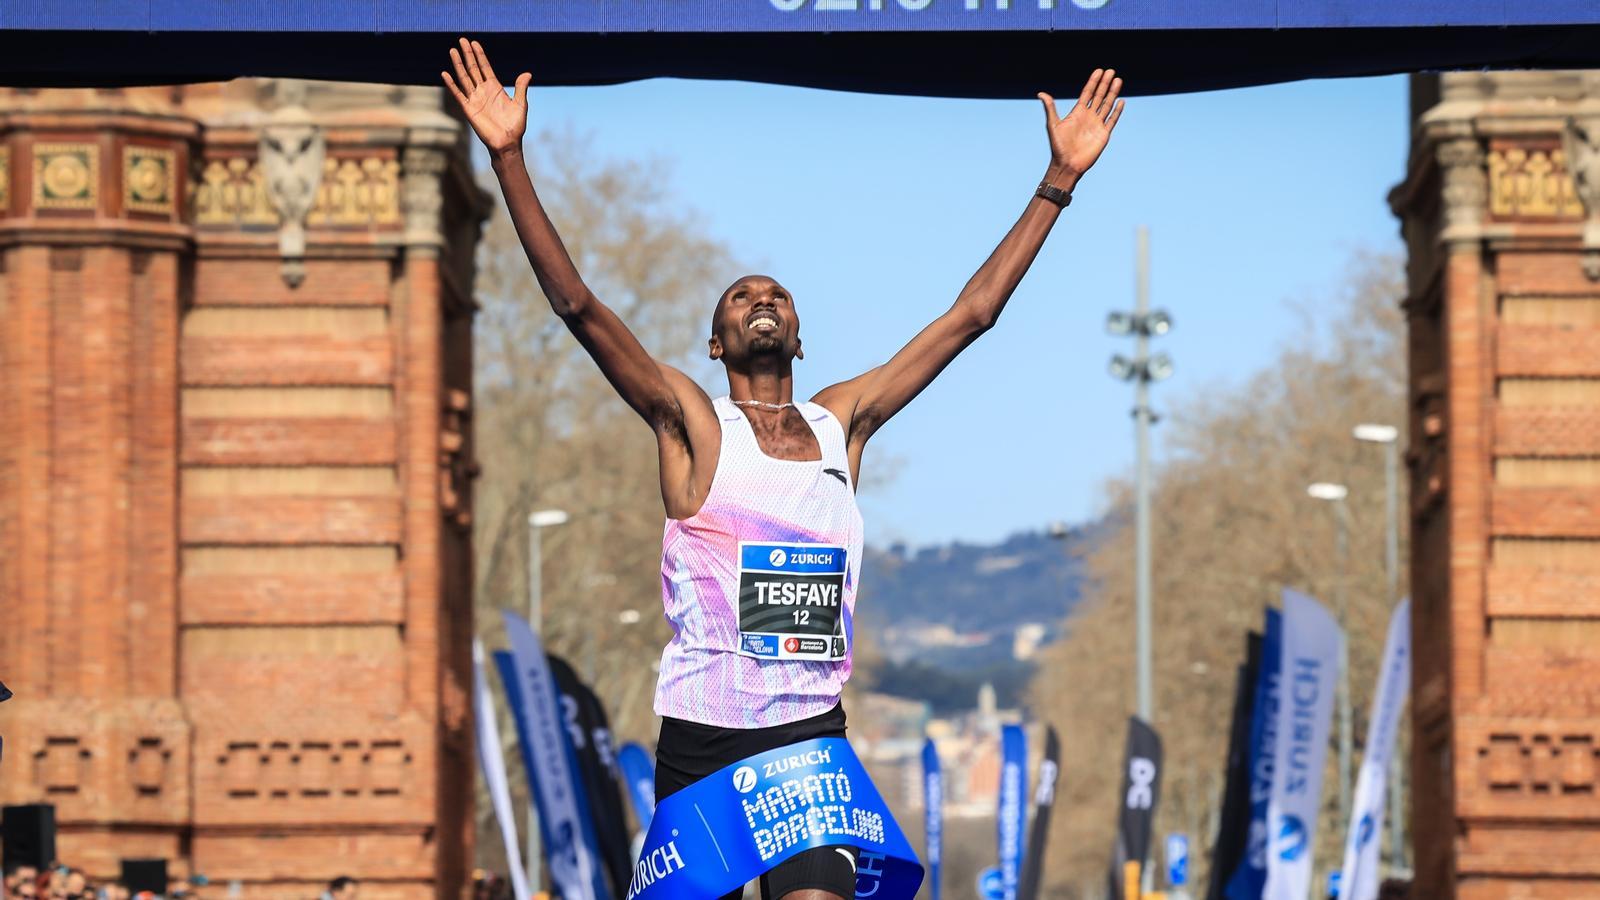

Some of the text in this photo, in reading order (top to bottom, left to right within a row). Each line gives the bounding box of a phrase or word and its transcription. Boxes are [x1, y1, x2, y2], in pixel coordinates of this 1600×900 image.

[790, 553, 833, 565] ZURICH
[754, 581, 838, 607] TESFAYE
[792, 609, 810, 625] 12
[762, 749, 831, 778] ZURICH
[741, 767, 852, 829] MARATÓ
[753, 804, 885, 862] BARCELONA
